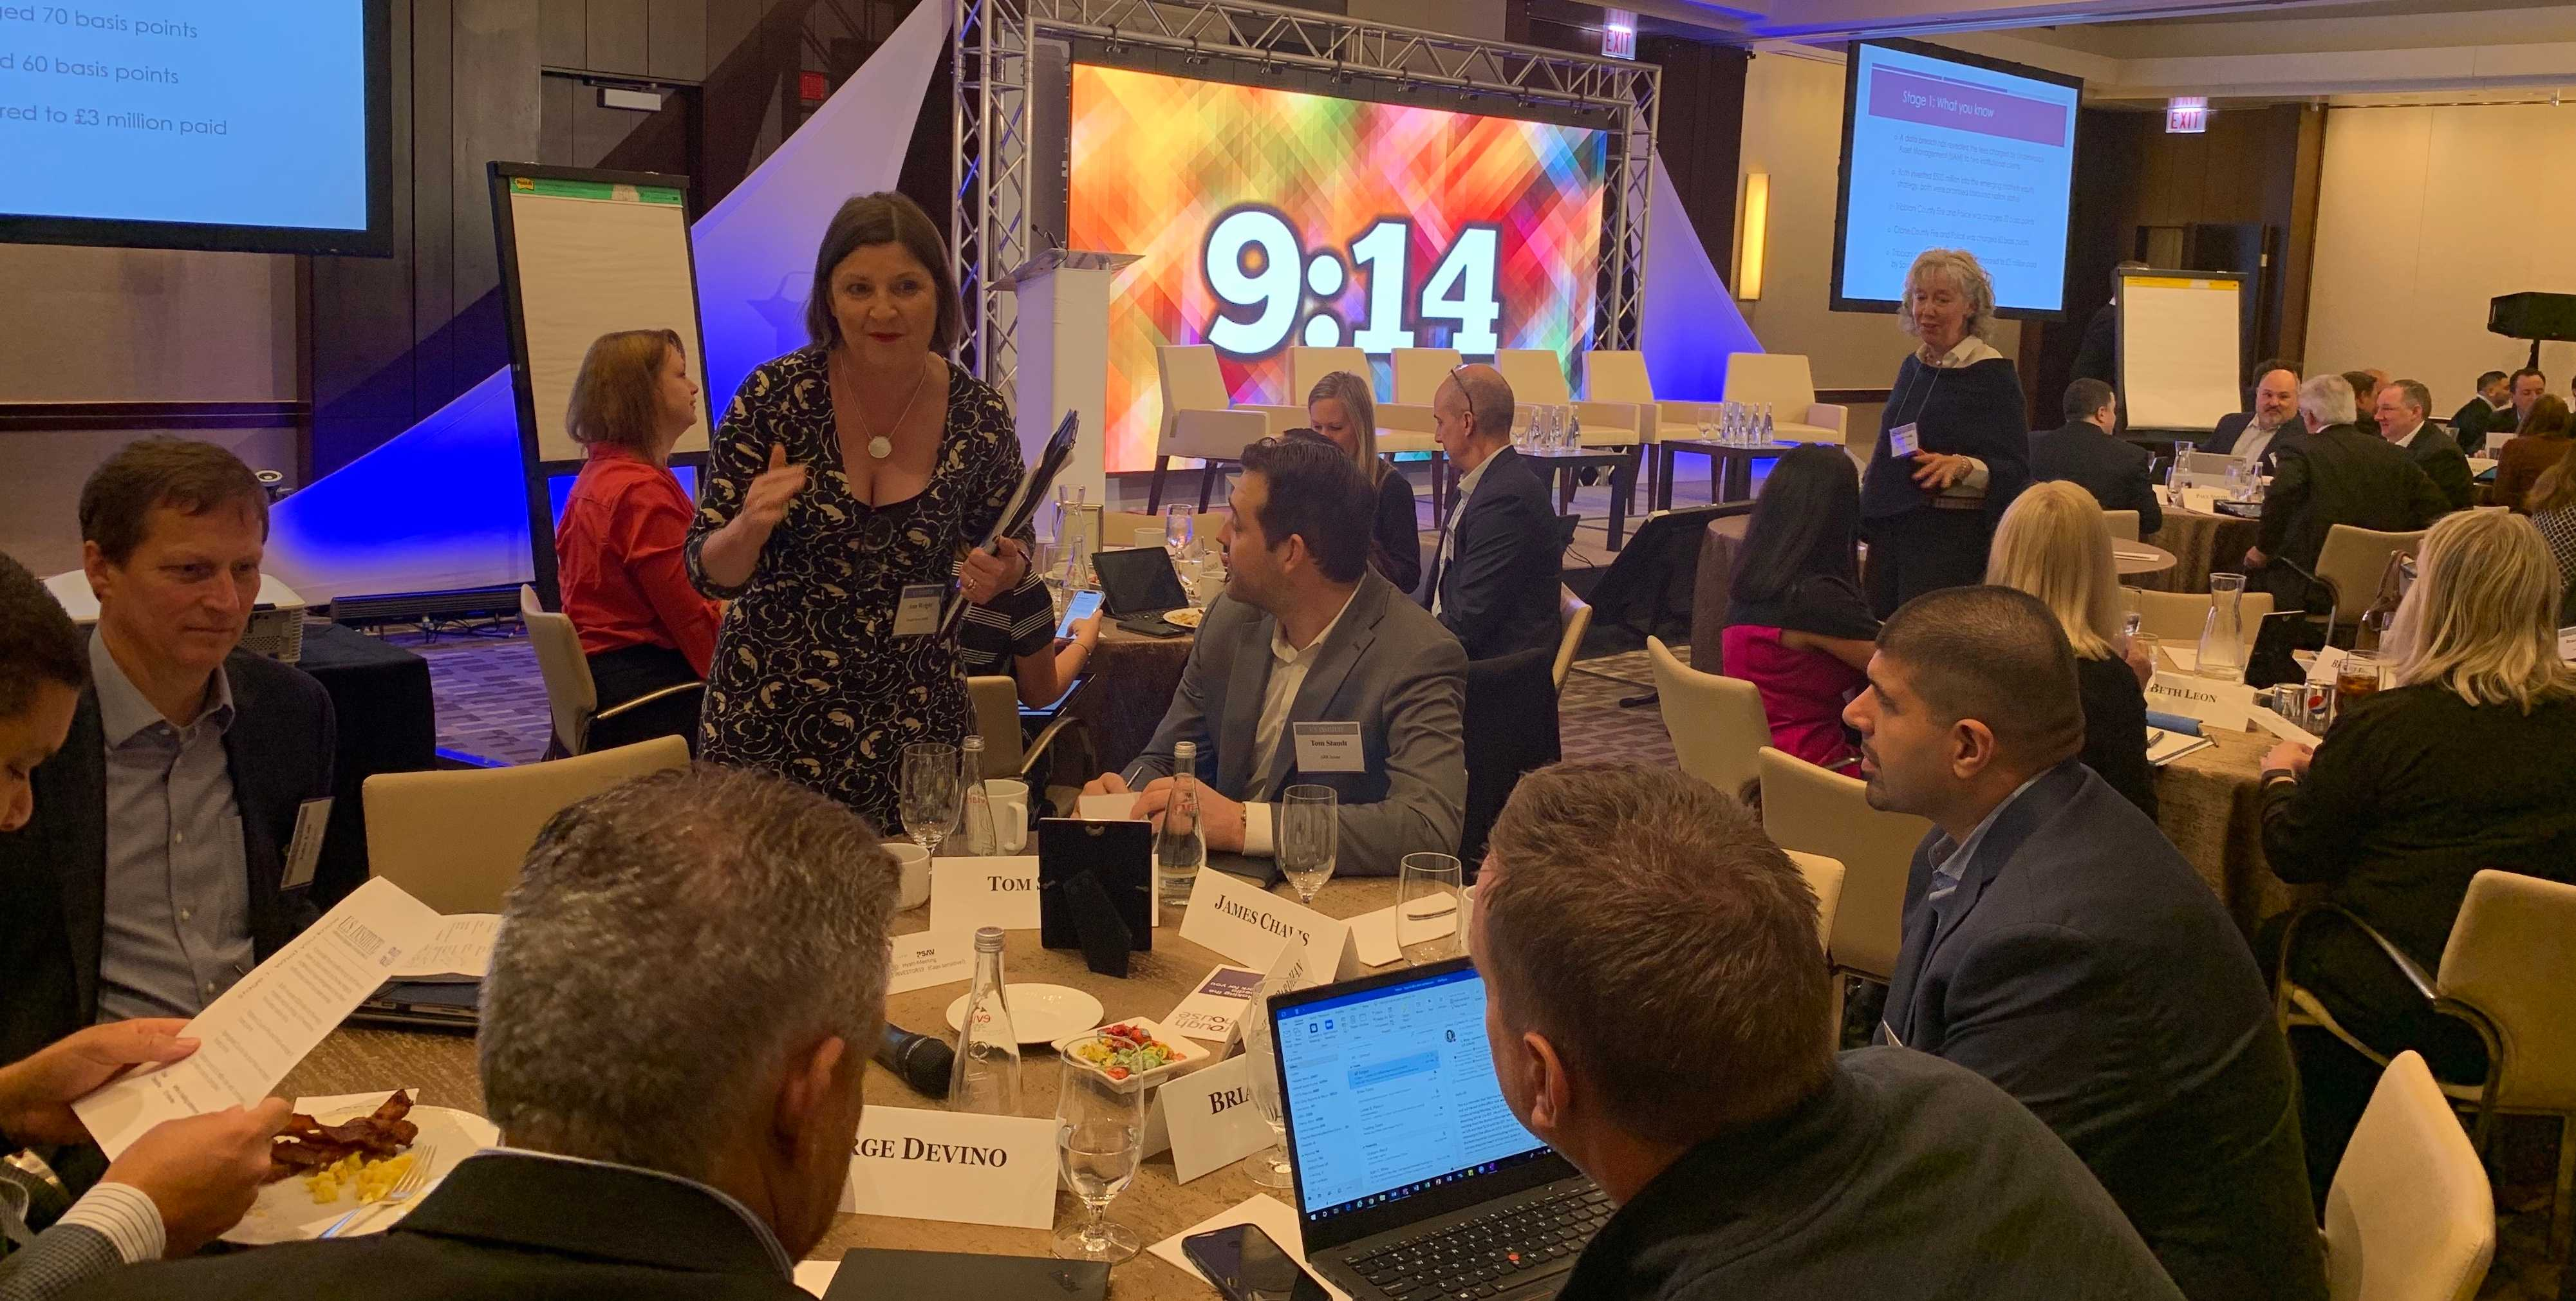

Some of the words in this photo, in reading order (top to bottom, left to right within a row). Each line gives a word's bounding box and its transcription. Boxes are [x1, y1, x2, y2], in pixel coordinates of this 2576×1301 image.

[42, 7, 67, 24] 70
[75, 10, 127, 31] basis
[135, 19, 198, 38] points
[1607, 30, 1631, 55] EXIT
[23, 55, 48, 72] 60
[55, 57, 108, 77] basis
[116, 66, 179, 84] points
[1903, 90, 1927, 108] Stage
[1937, 97, 1957, 111] What
[1959, 102, 1973, 115] you
[1974, 103, 1994, 117] know
[45, 106, 67, 123] to
[75, 108, 99, 126] £3
[107, 112, 173, 131] million
[180, 119, 227, 135] paid
[2171, 112, 2200, 129] EXIT
[1206, 211, 1500, 355] 9:14
[2151, 683, 2183, 698] BETH
[2184, 688, 2218, 704] LEON
[987, 875, 1032, 892] TOM
[1215, 894, 1259, 925] JAMES
[1260, 912, 1311, 947] CHAS
[1175, 1019, 1231, 1033] rough
[1179, 1011, 1235, 1026] house
[901, 1137, 1008, 1168] DEVINO
